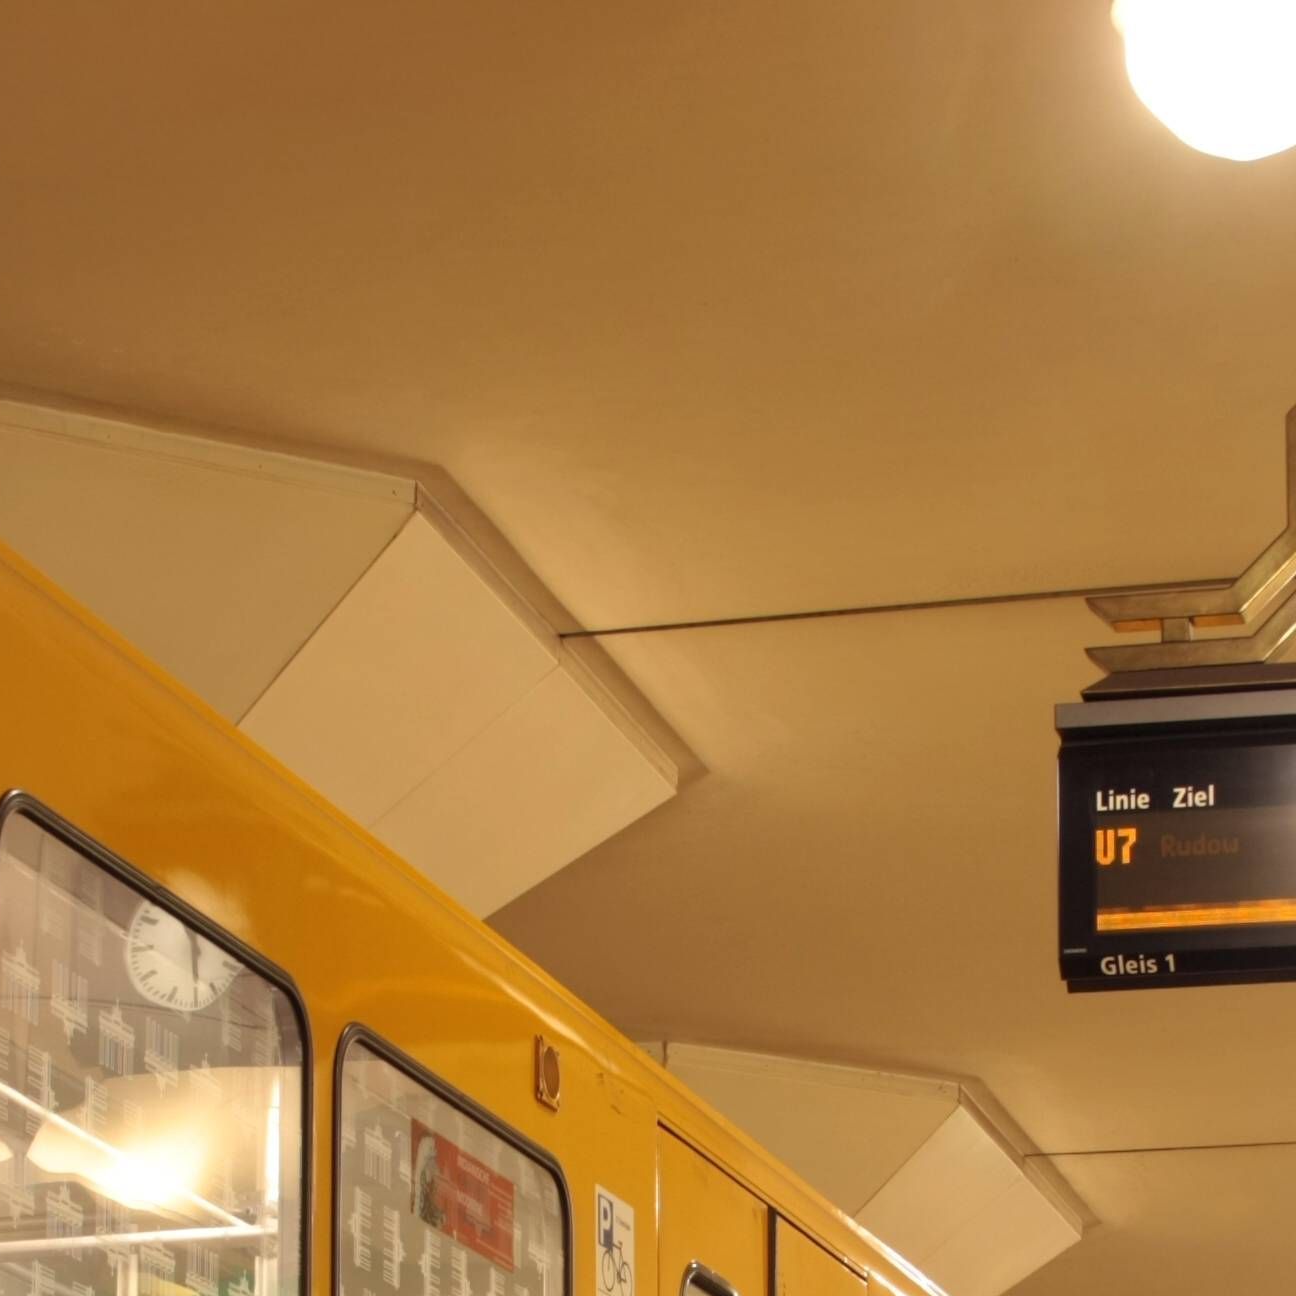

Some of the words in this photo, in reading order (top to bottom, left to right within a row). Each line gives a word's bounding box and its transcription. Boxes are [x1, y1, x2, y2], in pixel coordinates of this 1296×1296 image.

[1096, 789, 1150, 811] Linie
[1172, 784, 1215, 808] Ziel
[1095, 828, 1137, 865] U7
[1161, 834, 1239, 857] Rudow
[1100, 954, 1158, 976] Gleis
[1164, 953, 1175, 973] 1
